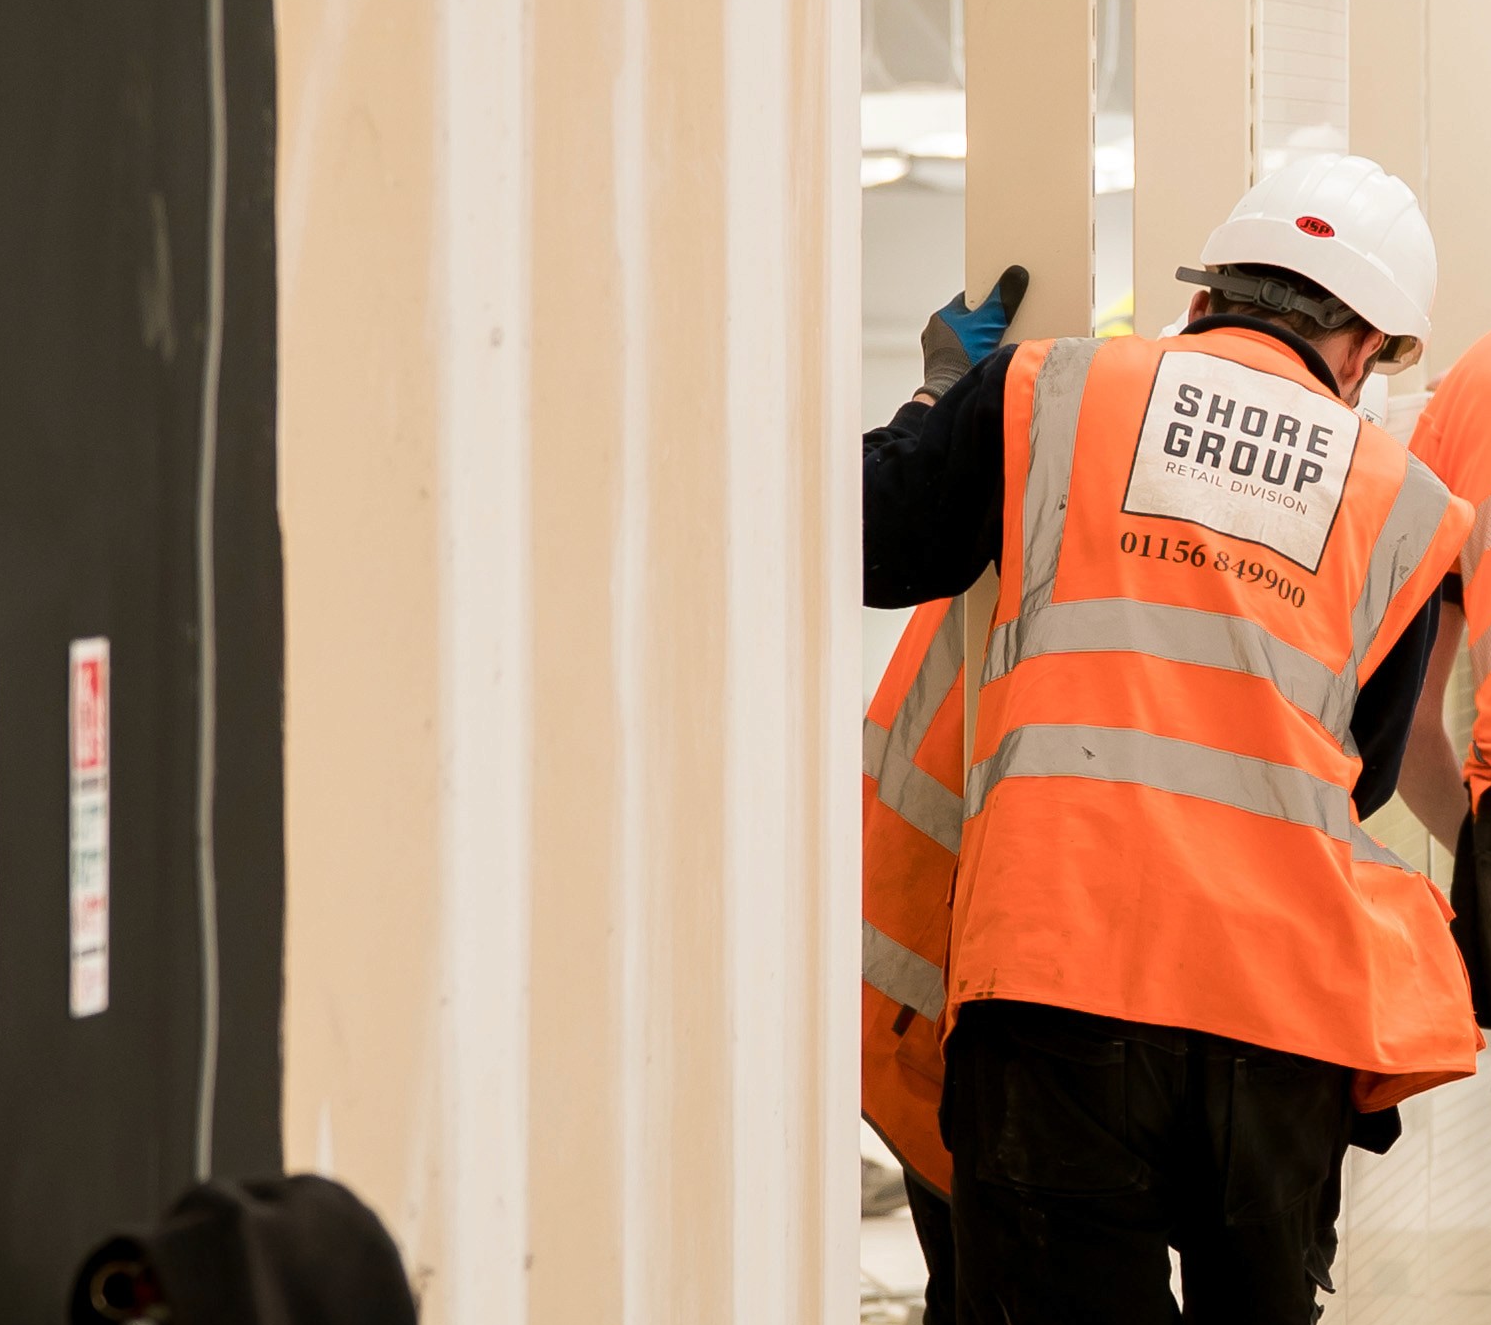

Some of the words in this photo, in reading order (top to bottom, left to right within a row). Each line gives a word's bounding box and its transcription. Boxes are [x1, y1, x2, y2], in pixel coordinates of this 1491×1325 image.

[1163, 421, 1324, 493] GROUP
[1173, 383, 1334, 459] SHORE
[1165, 461, 1224, 488] RETAIL
[1229, 479, 1308, 515] DIVISION
[1120, 531, 1207, 568] 01156
[1213, 551, 1306, 609] 849900
